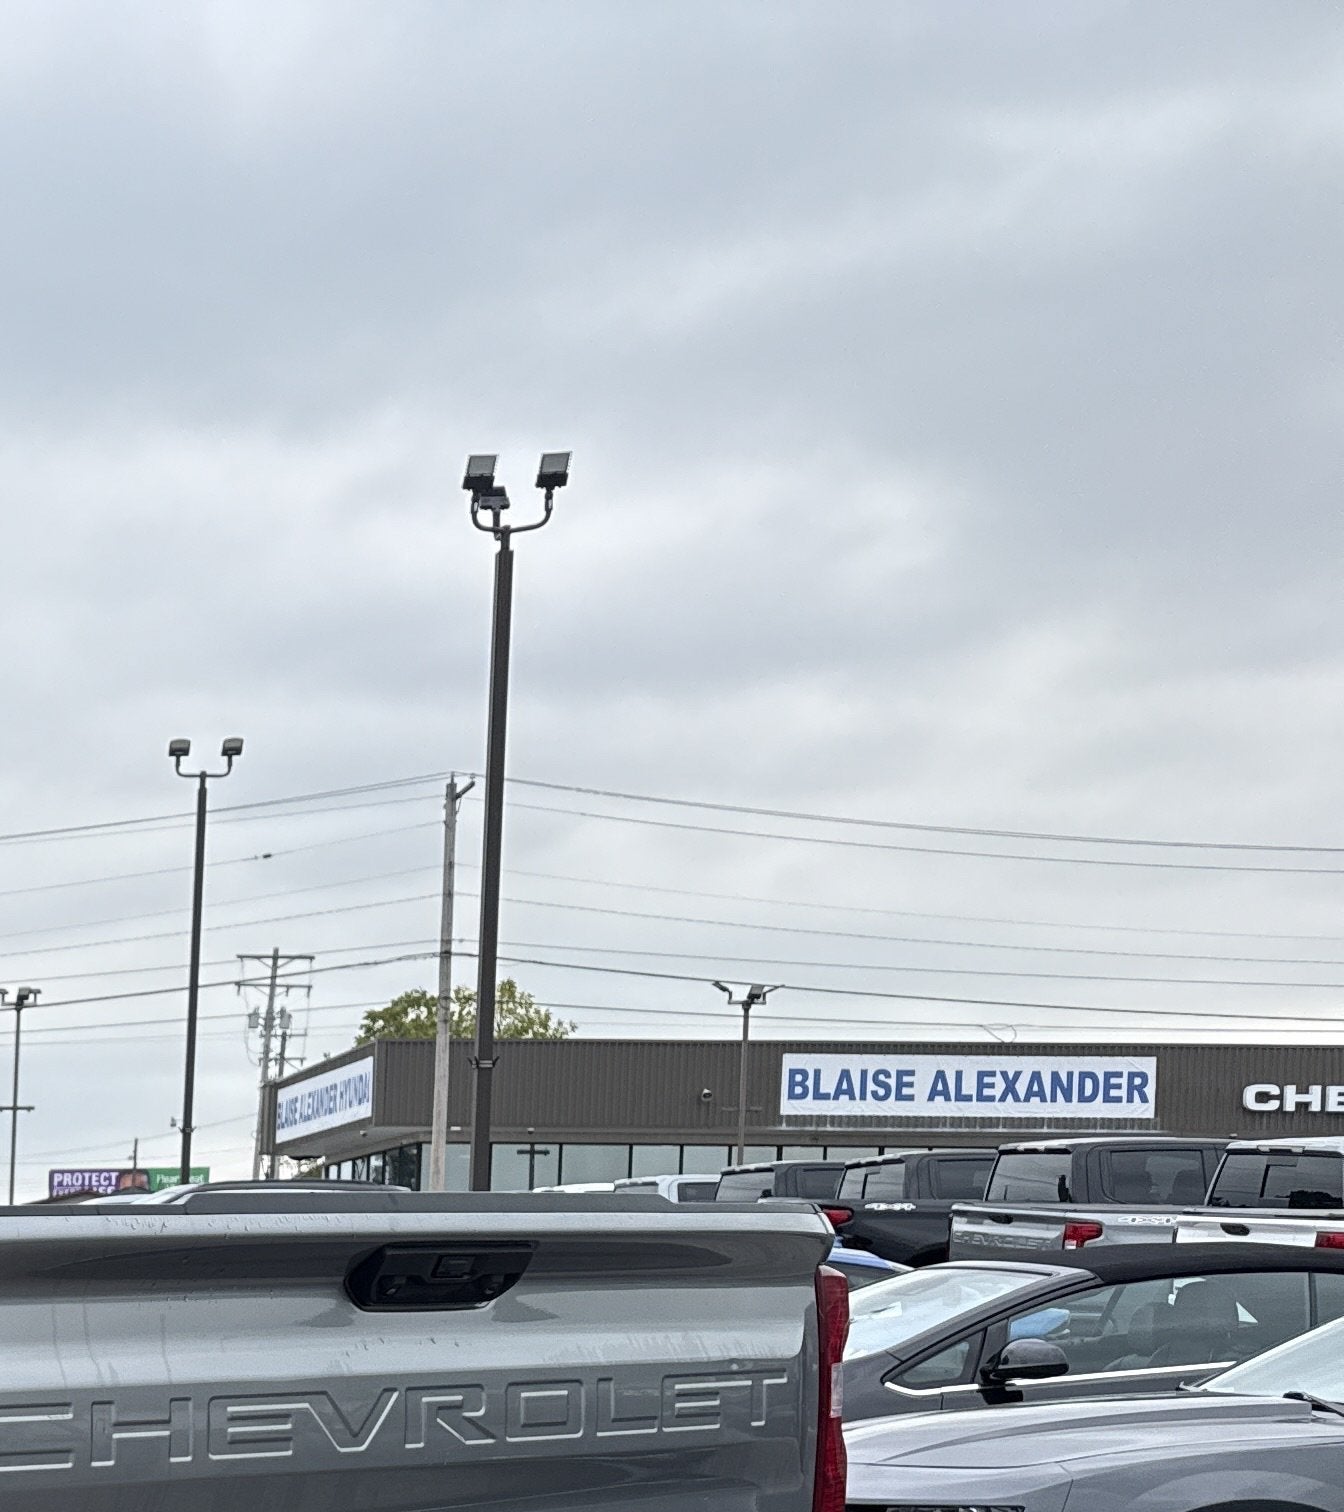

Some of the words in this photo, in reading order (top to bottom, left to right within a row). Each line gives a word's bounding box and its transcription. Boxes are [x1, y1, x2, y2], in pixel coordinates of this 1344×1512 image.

[277, 1096, 298, 1131] BLAISE
[298, 1083, 337, 1124] ALEXANDER
[339, 1071, 371, 1112] HYUNDAI
[787, 1068, 916, 1101] BLAISE
[927, 1070, 1150, 1104] ALEXANDER
[1242, 1083, 1344, 1112] CHE
[53, 1171, 120, 1186] PROTECT
